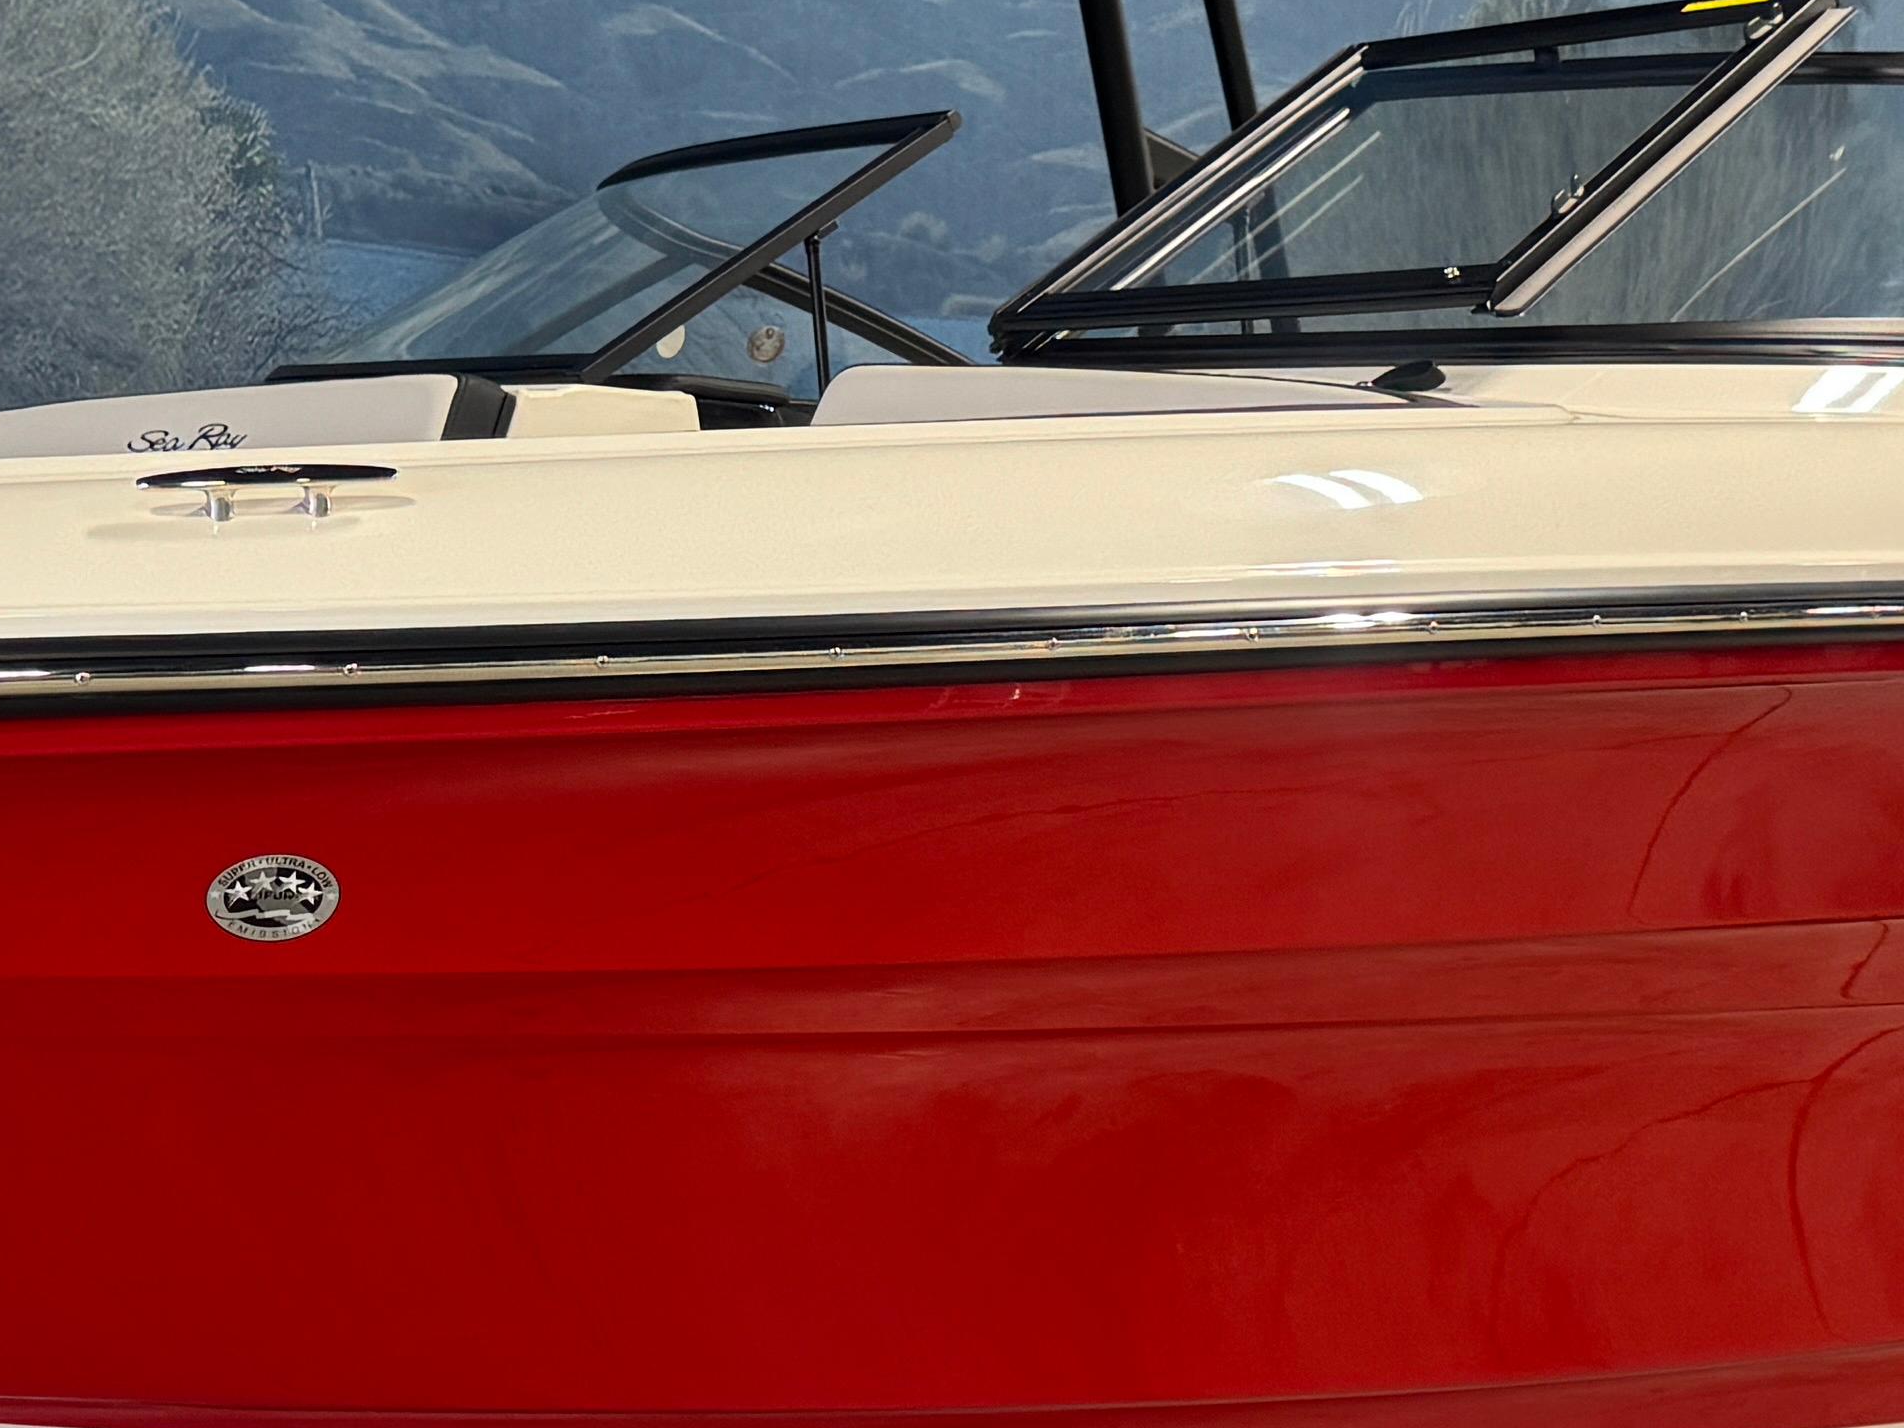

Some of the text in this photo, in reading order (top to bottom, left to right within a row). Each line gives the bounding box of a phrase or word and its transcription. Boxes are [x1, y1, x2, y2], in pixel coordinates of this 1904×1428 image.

[128, 423, 248, 453] Sea Ray
[218, 856, 334, 889] SUPER ULTRA LOW
